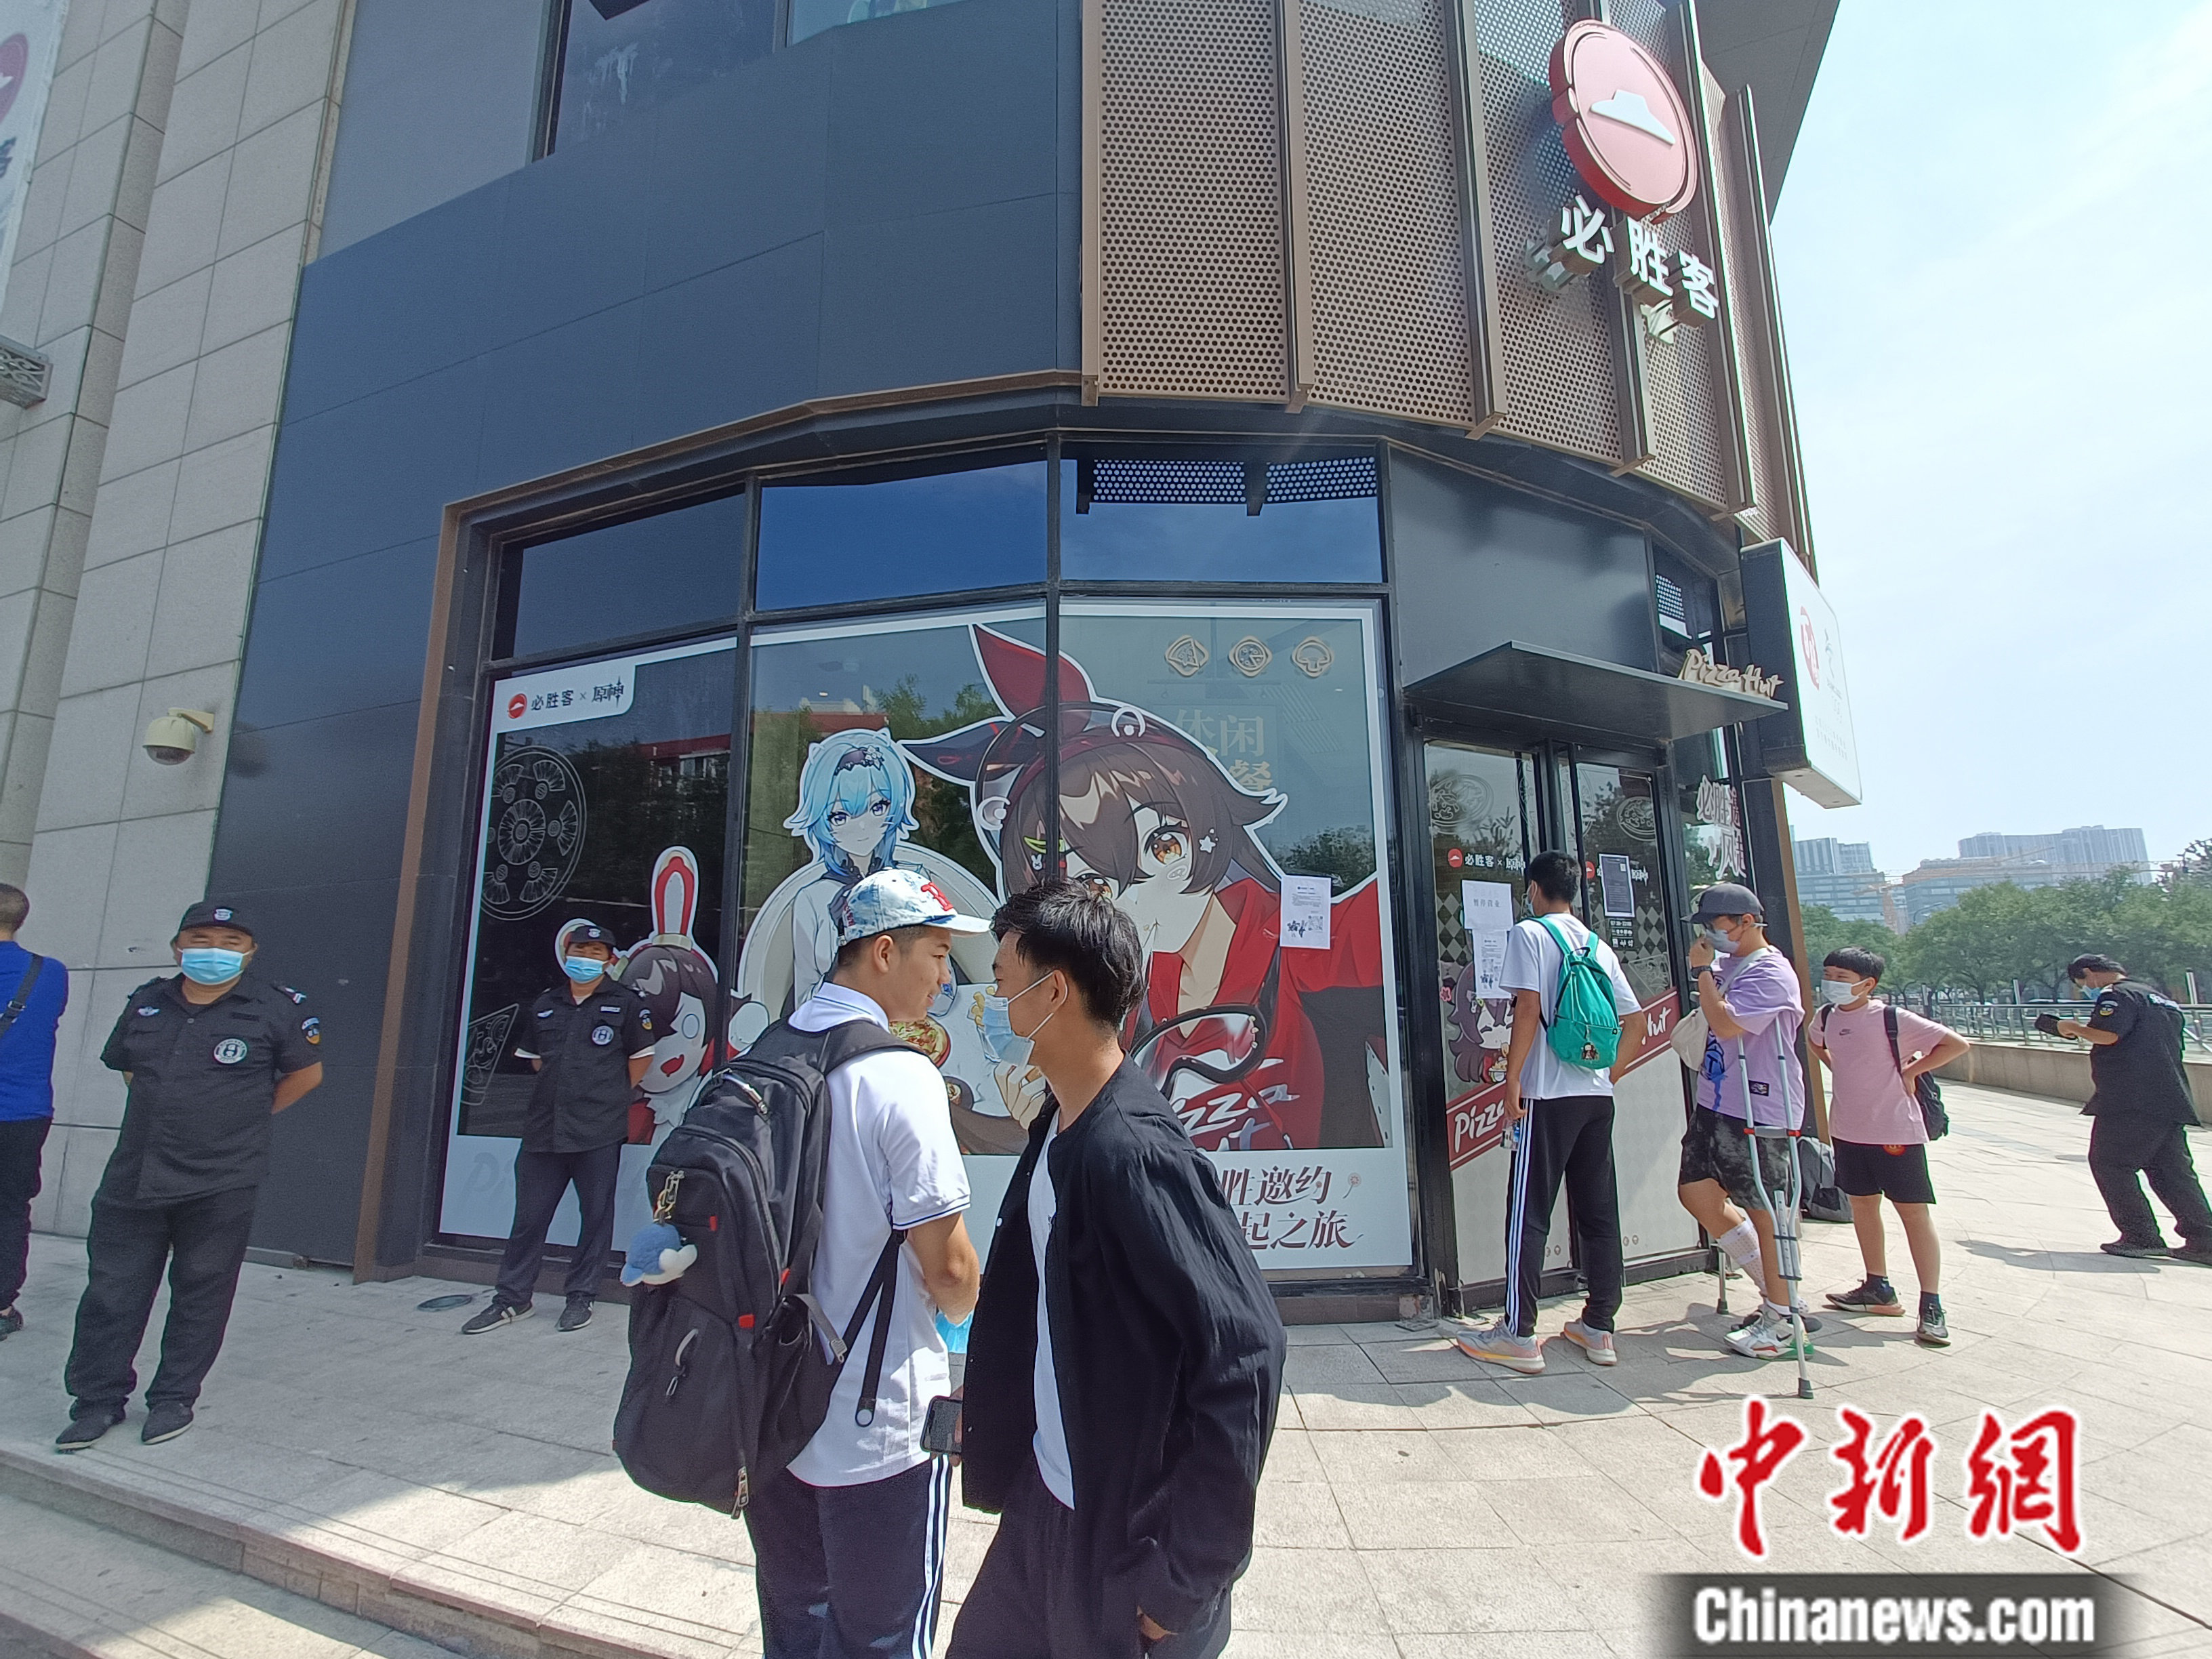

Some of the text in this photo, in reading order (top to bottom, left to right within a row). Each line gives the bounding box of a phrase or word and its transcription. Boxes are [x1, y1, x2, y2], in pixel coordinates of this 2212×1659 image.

[1561, 195, 1719, 320] 必胜客
[531, 690, 574, 711] 必胜客
[592, 676, 624, 708] 原神
[1684, 649, 1742, 687] Pizza
[1740, 664, 1784, 698] Hut
[1174, 709, 1265, 757] 休闲
[1465, 853, 1494, 867] 必胜客
[1222, 1165, 1332, 1206] 胜邀约
[1240, 1210, 1357, 1250] 起之旅
